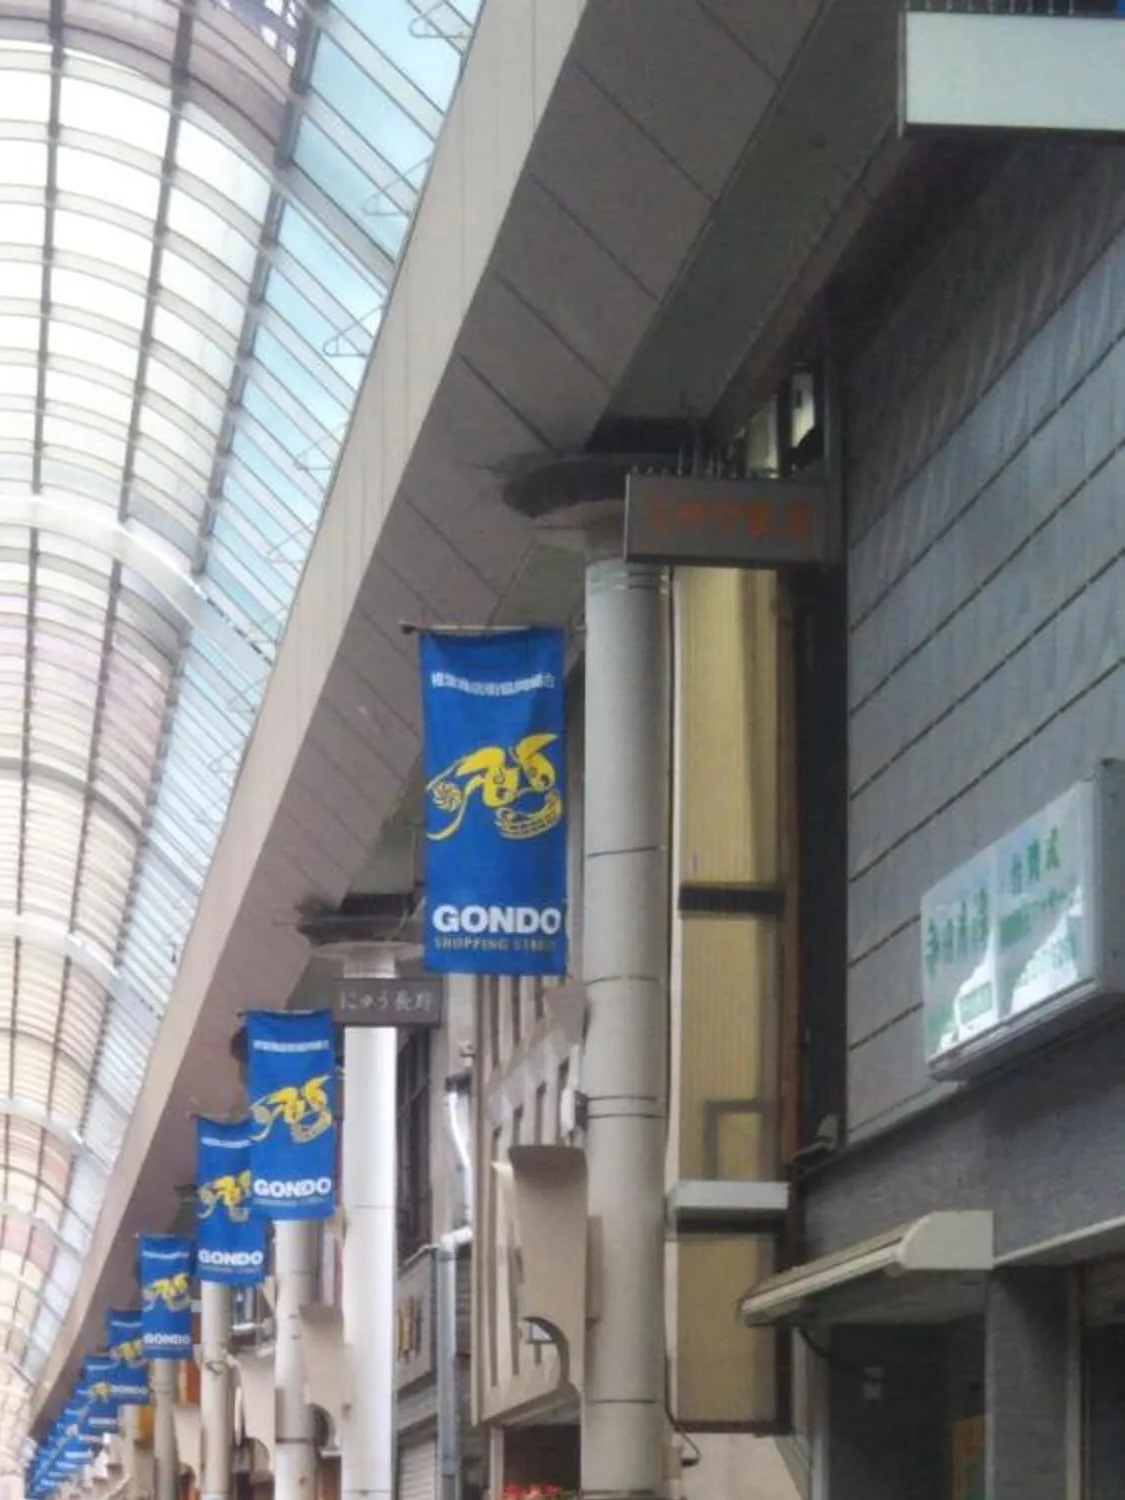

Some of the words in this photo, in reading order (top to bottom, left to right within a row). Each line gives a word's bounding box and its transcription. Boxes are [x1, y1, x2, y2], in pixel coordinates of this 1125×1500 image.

[432, 904, 562, 935] GONDO
[253, 1177, 332, 1198] GONDO
[198, 1249, 264, 1266] GONDO
